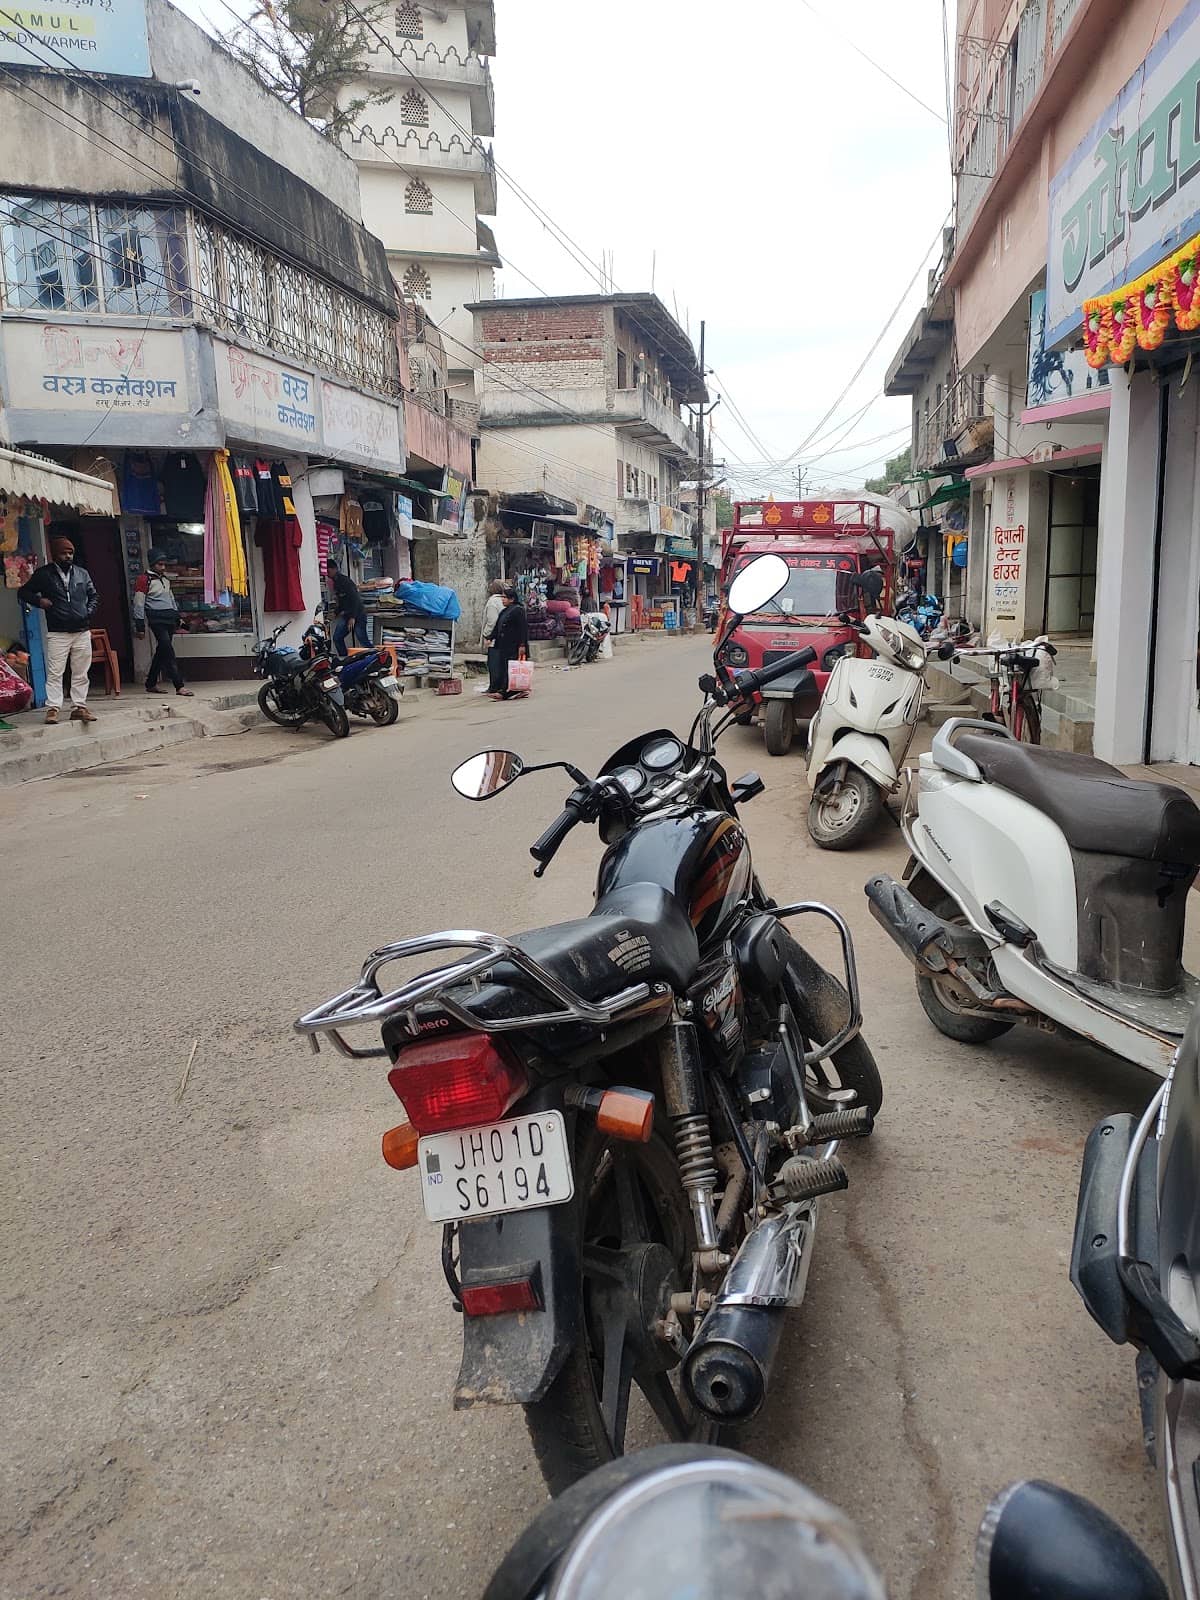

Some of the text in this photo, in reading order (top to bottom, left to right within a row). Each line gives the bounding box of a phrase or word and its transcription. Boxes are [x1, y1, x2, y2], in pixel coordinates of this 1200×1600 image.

[43, 374, 177, 398] वस्त्र कलेक्शन
[281, 372, 309, 403] वस्त्र
[277, 403, 315, 433] कलेक्शन
[994, 525, 1025, 545] दिपाली
[996, 547, 1021, 561] टेन्ट
[993, 564, 1021, 580] हाउस
[418, 1017, 449, 1032] Hero
[454, 1122, 543, 1170] JH01D
[428, 1173, 444, 1186] IND
[455, 1162, 550, 1212] S6194
